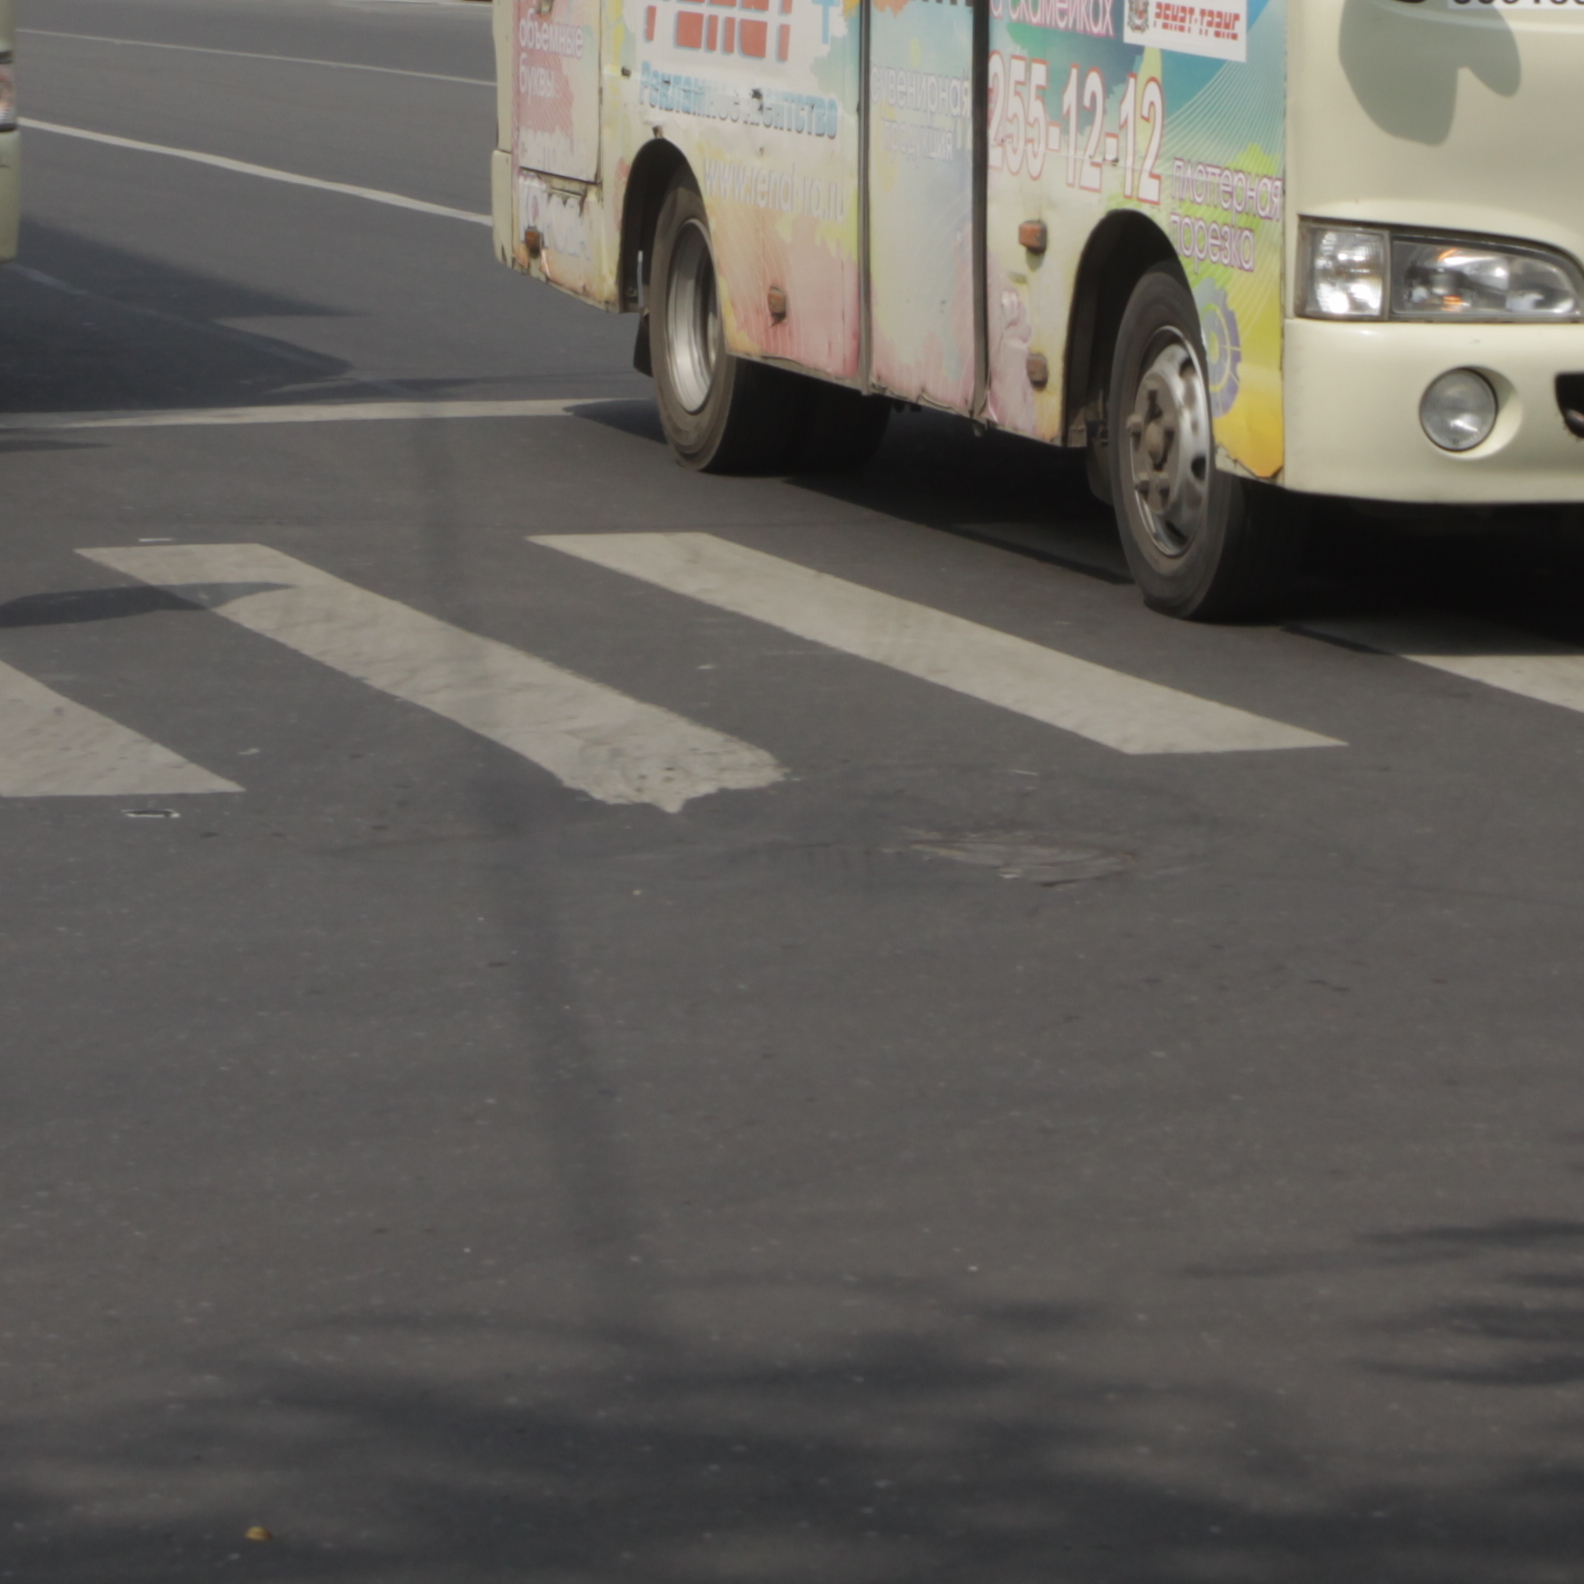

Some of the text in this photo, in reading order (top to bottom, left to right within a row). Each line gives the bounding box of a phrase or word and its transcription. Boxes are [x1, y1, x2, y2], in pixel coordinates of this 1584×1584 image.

[519, 7, 584, 58] объемные
[870, 65, 971, 126] сувенирная
[987, 49, 1165, 206] 255-12-12
[1171, 156, 1284, 227] плоттерная
[1169, 211, 1255, 276] порезка
